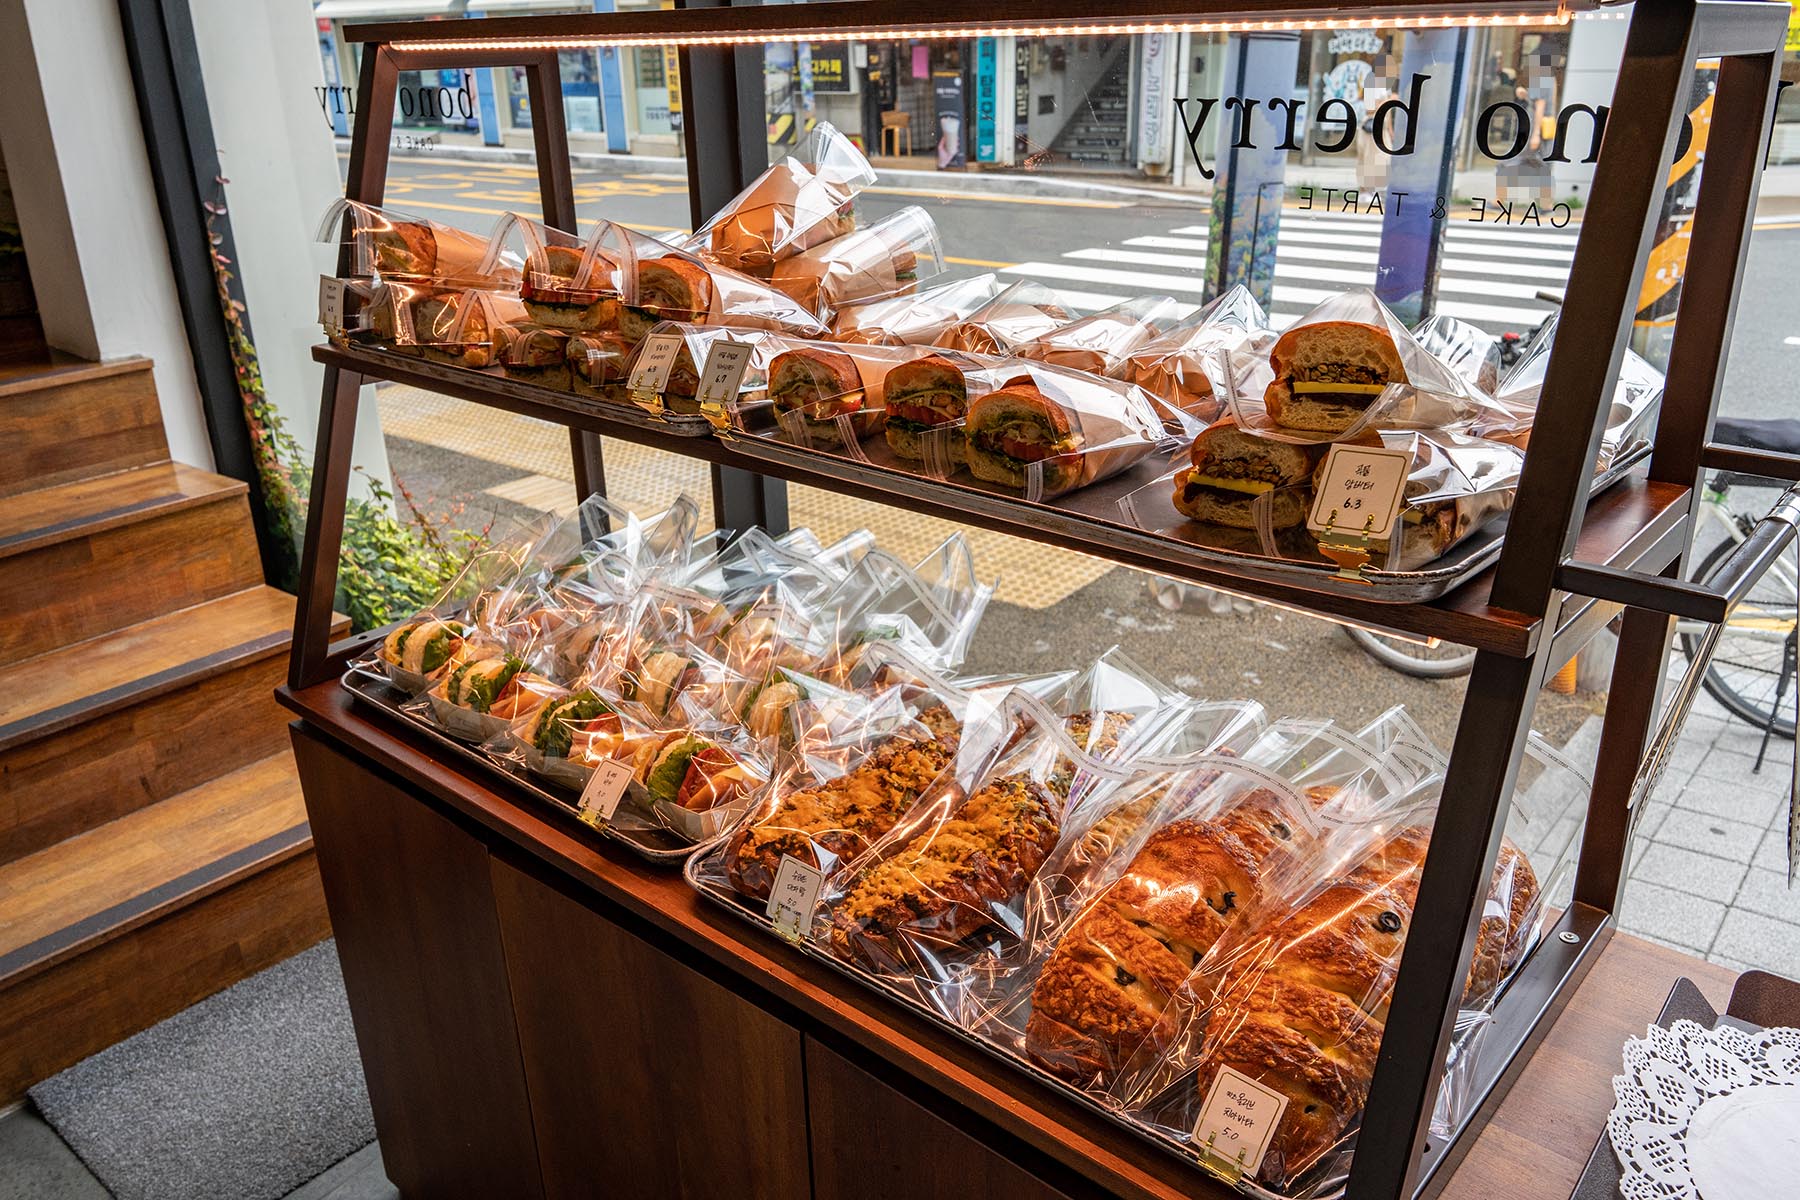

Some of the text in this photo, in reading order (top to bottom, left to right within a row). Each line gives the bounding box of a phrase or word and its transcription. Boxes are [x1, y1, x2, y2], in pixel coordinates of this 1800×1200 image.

[1344, 479, 1375, 491] 앙버터
[1343, 497, 1363, 510] 6.3
[1223, 1107, 1255, 1128] 치아바타
[1222, 1127, 1239, 1140] 5.0
